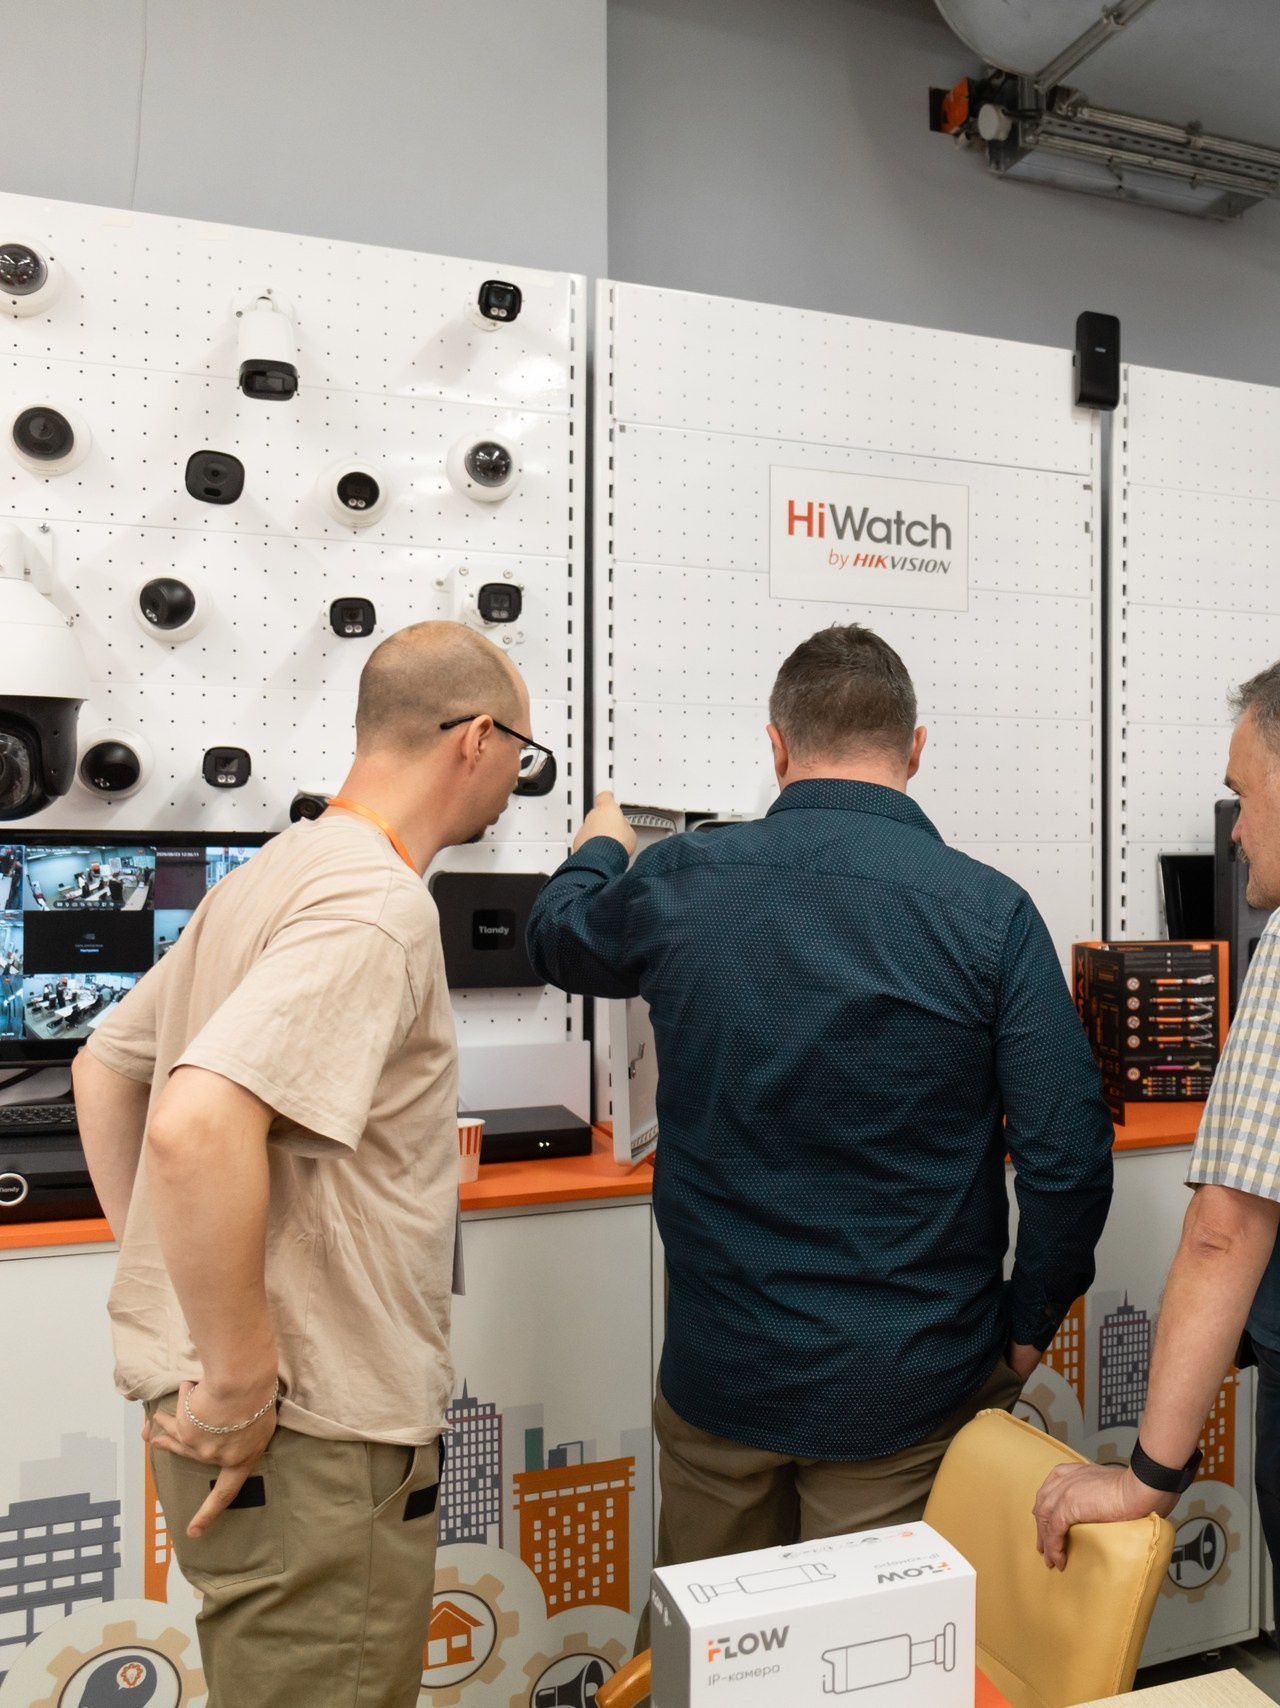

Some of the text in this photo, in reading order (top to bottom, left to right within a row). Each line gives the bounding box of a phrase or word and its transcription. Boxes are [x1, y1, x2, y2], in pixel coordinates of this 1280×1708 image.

[787, 499, 952, 550] HiWatch
[828, 548, 952, 574] by HIKVISION
[478, 925, 510, 936] Tiandy
